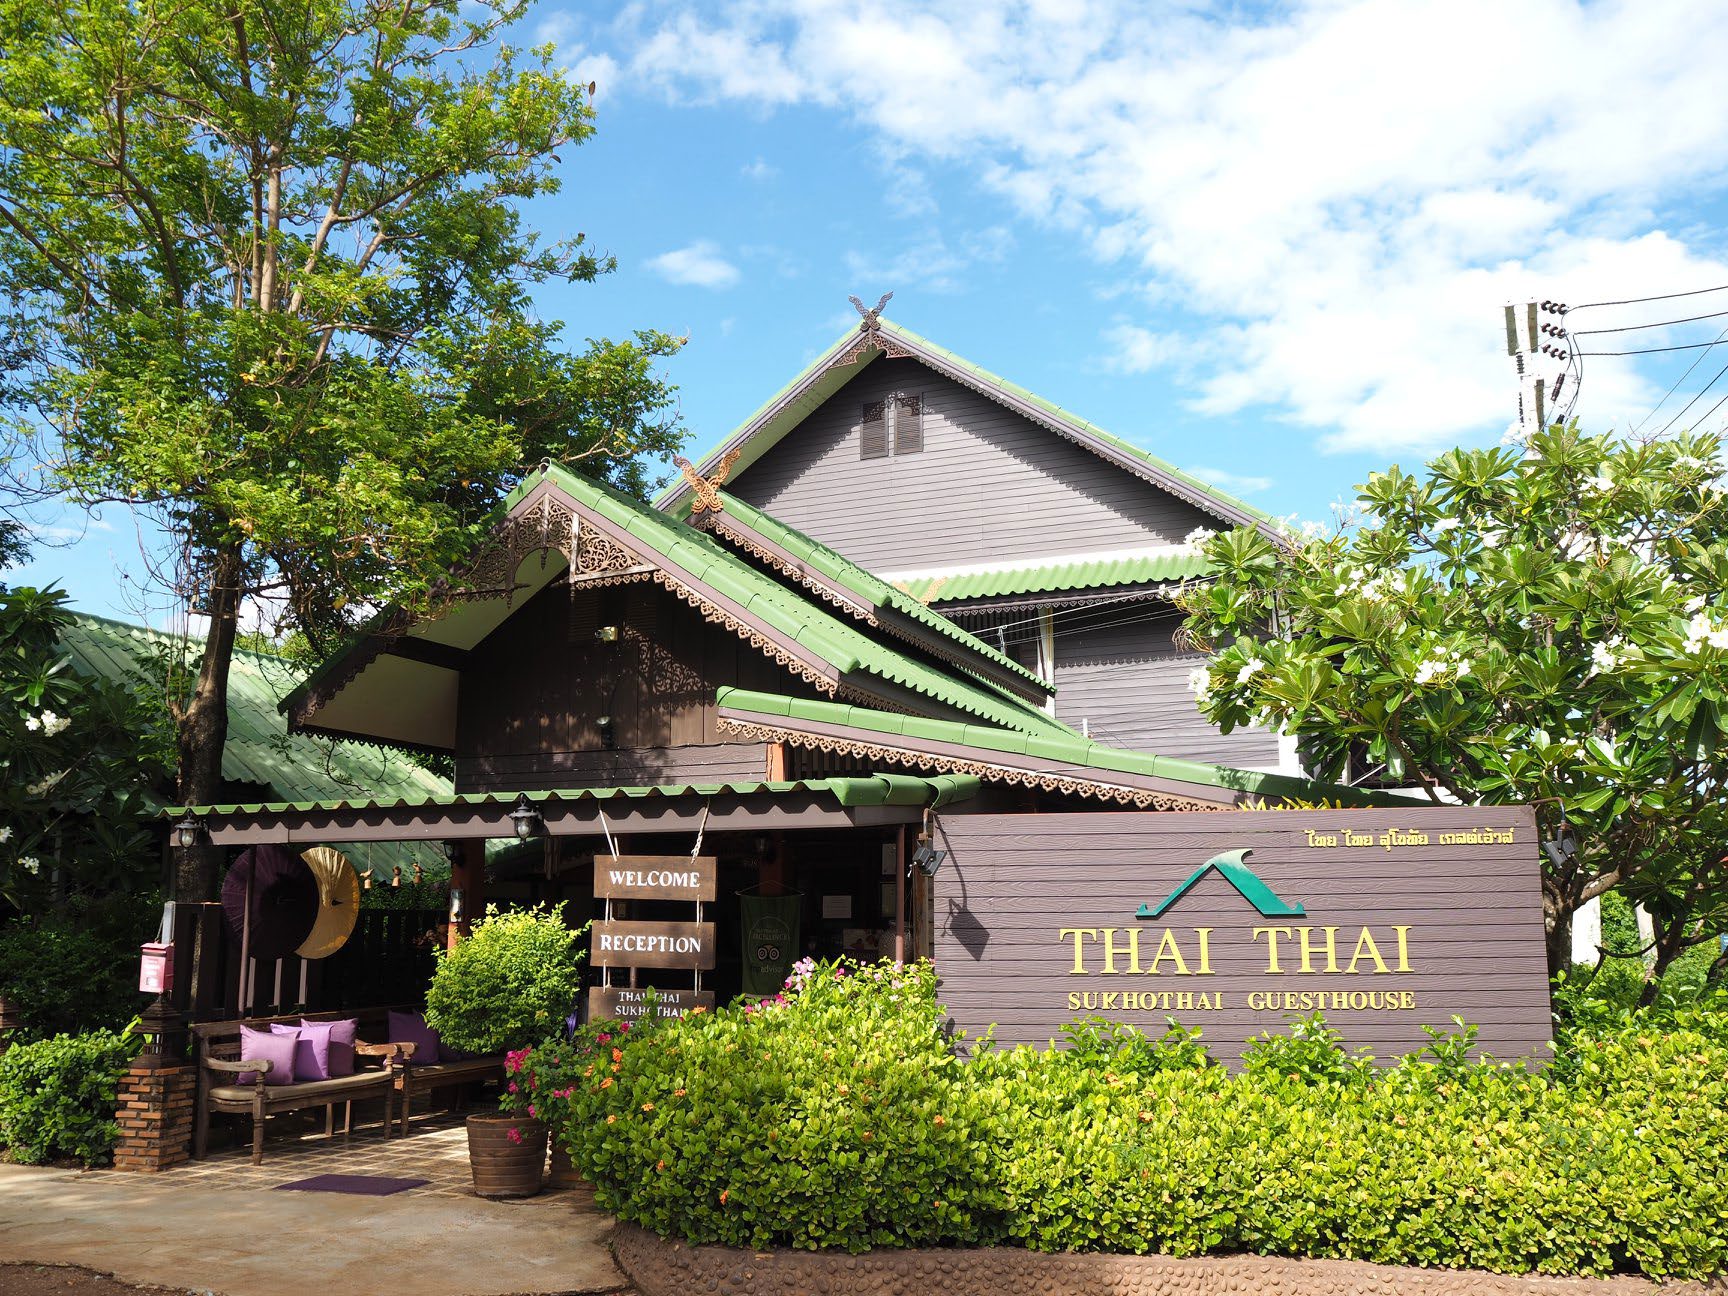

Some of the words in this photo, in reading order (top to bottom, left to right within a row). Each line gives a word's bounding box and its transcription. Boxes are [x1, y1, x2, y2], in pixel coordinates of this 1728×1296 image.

[1304, 829, 1337, 847] ไทย
[1340, 829, 1373, 847] ไทย
[1379, 828, 1429, 852] สุโขทัย
[609, 870, 701, 888] WELCOME
[600, 934, 701, 953] RECEPTION
[1060, 927, 1215, 975] THAI
[1253, 925, 1415, 975] THAI
[1068, 991, 1224, 1011] SUKHOTHAI
[1248, 990, 1415, 1011] GUESTHOUSE
